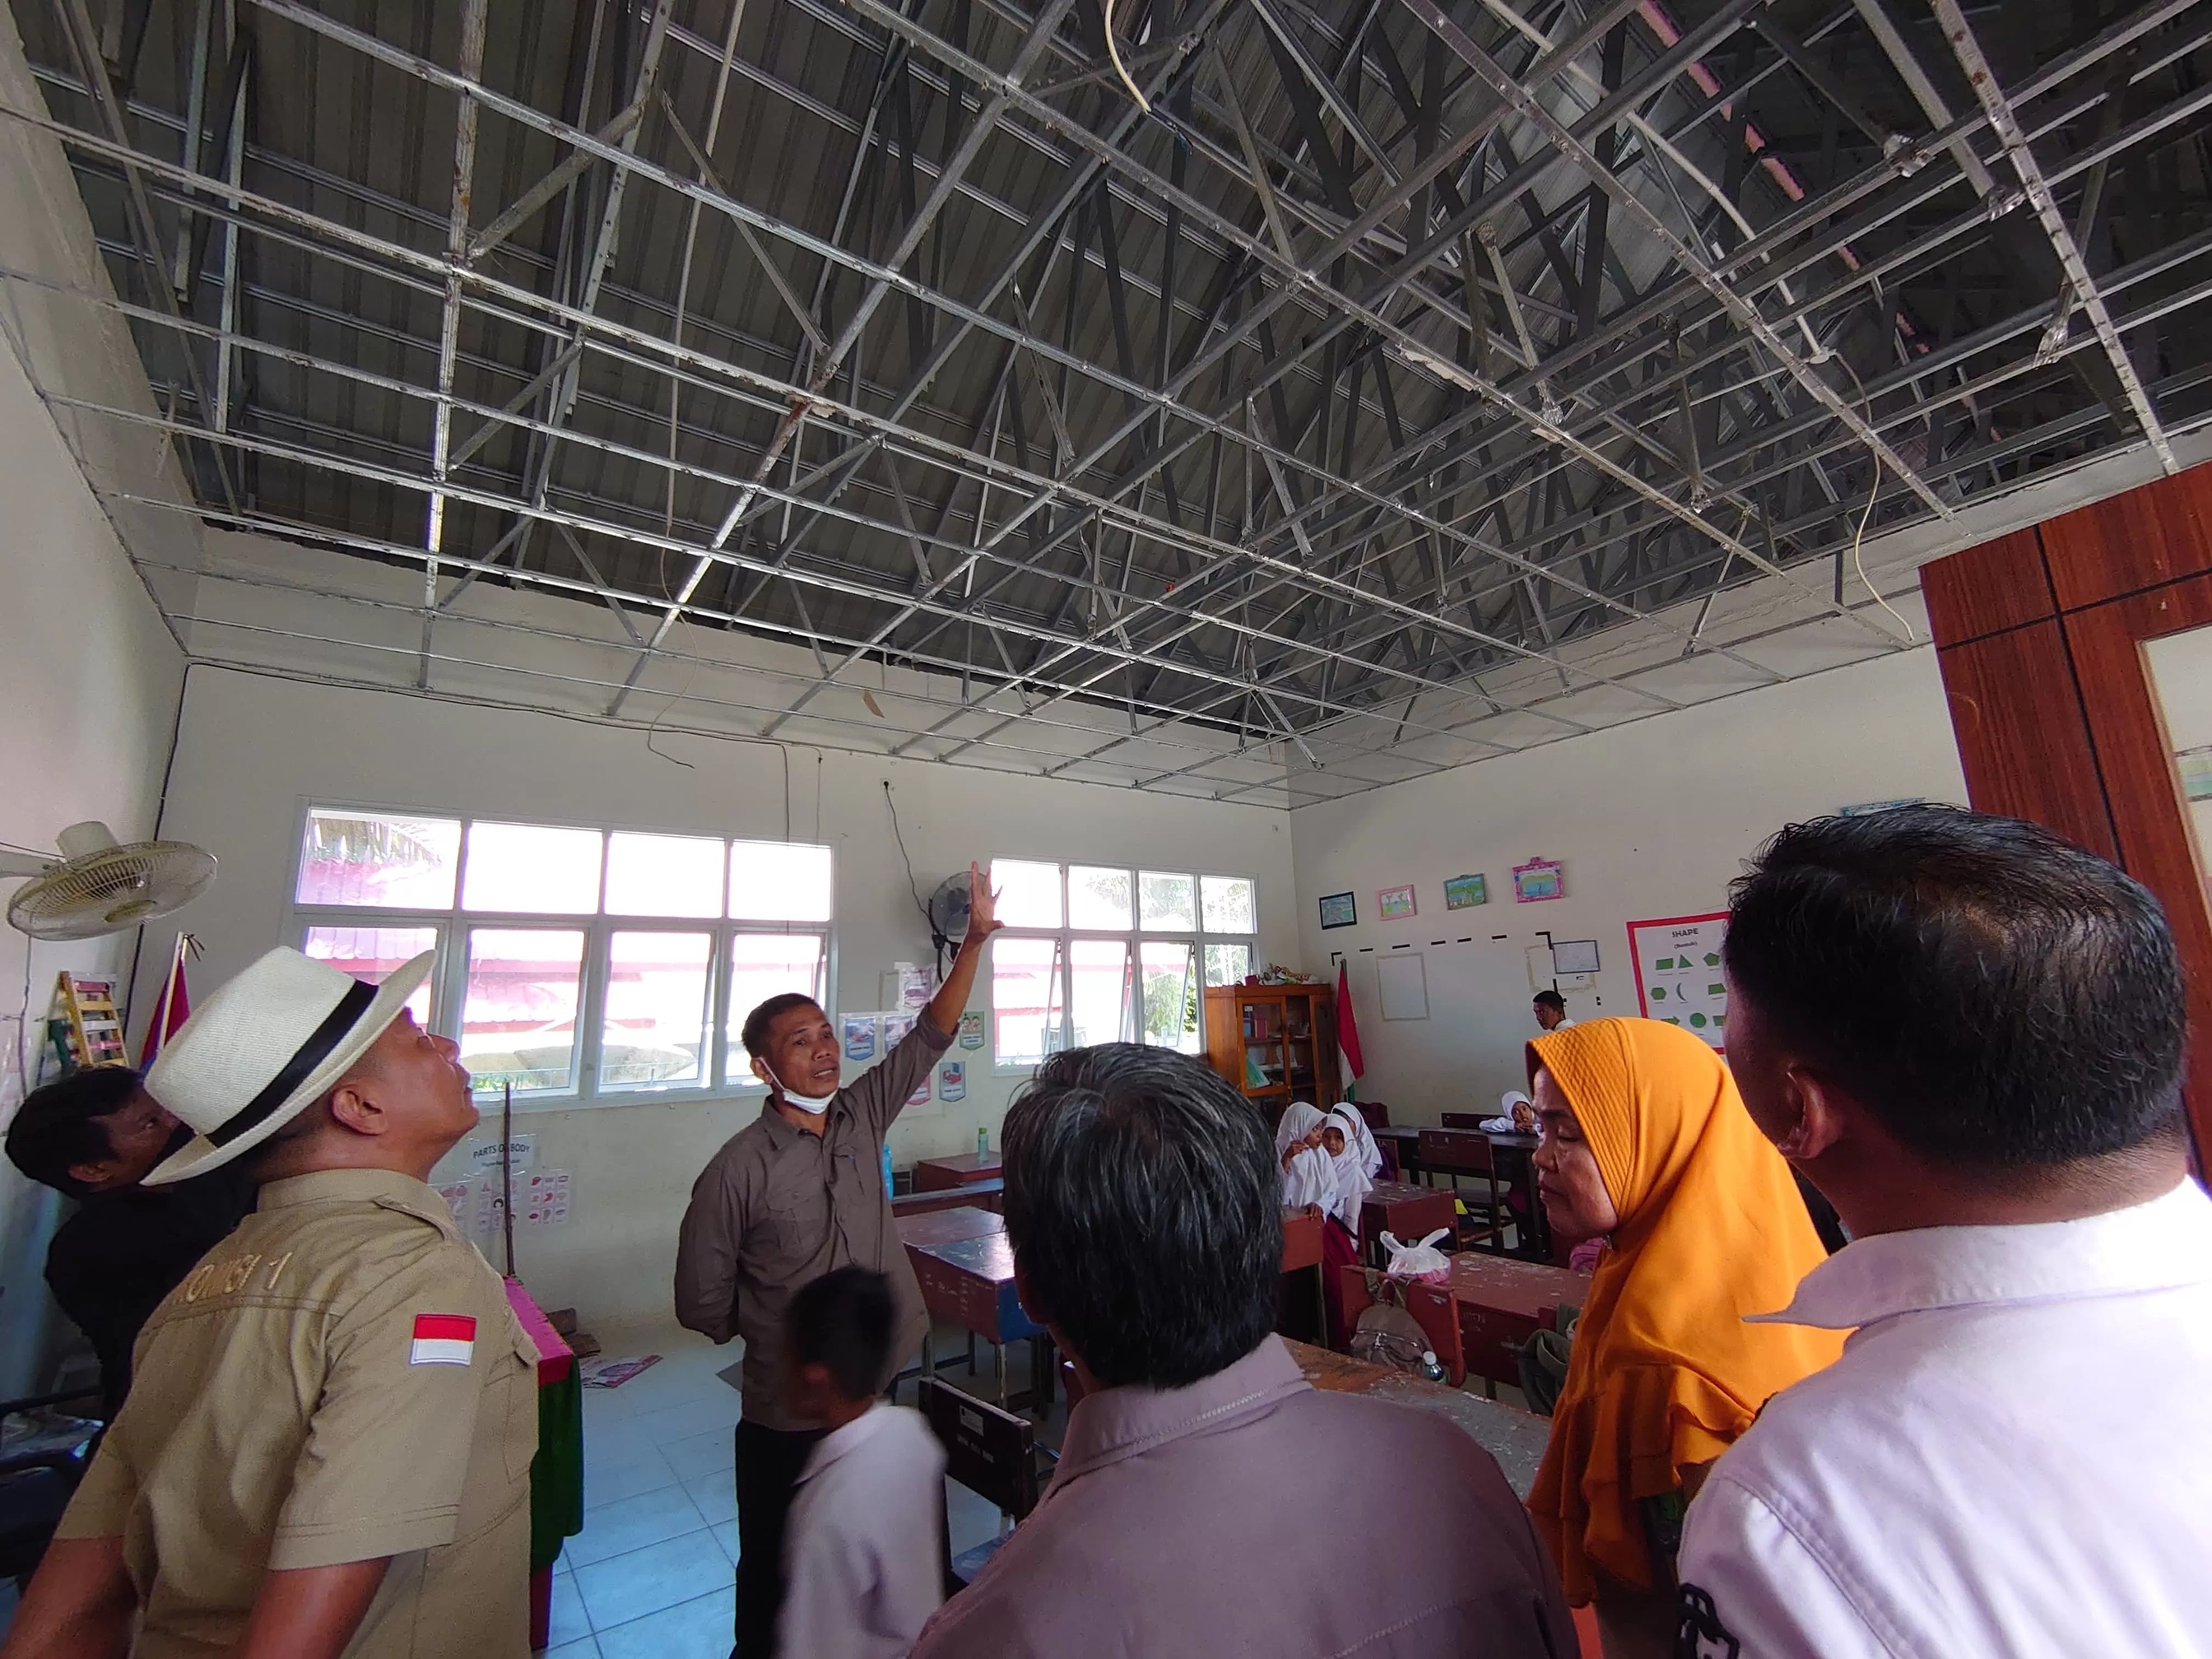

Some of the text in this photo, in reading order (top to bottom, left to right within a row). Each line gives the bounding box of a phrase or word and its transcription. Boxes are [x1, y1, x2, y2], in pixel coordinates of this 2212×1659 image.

[1671, 927, 1699, 938] SHAPE
[472, 1144, 497, 1159] PARTS
[510, 1143, 531, 1153] BODY
